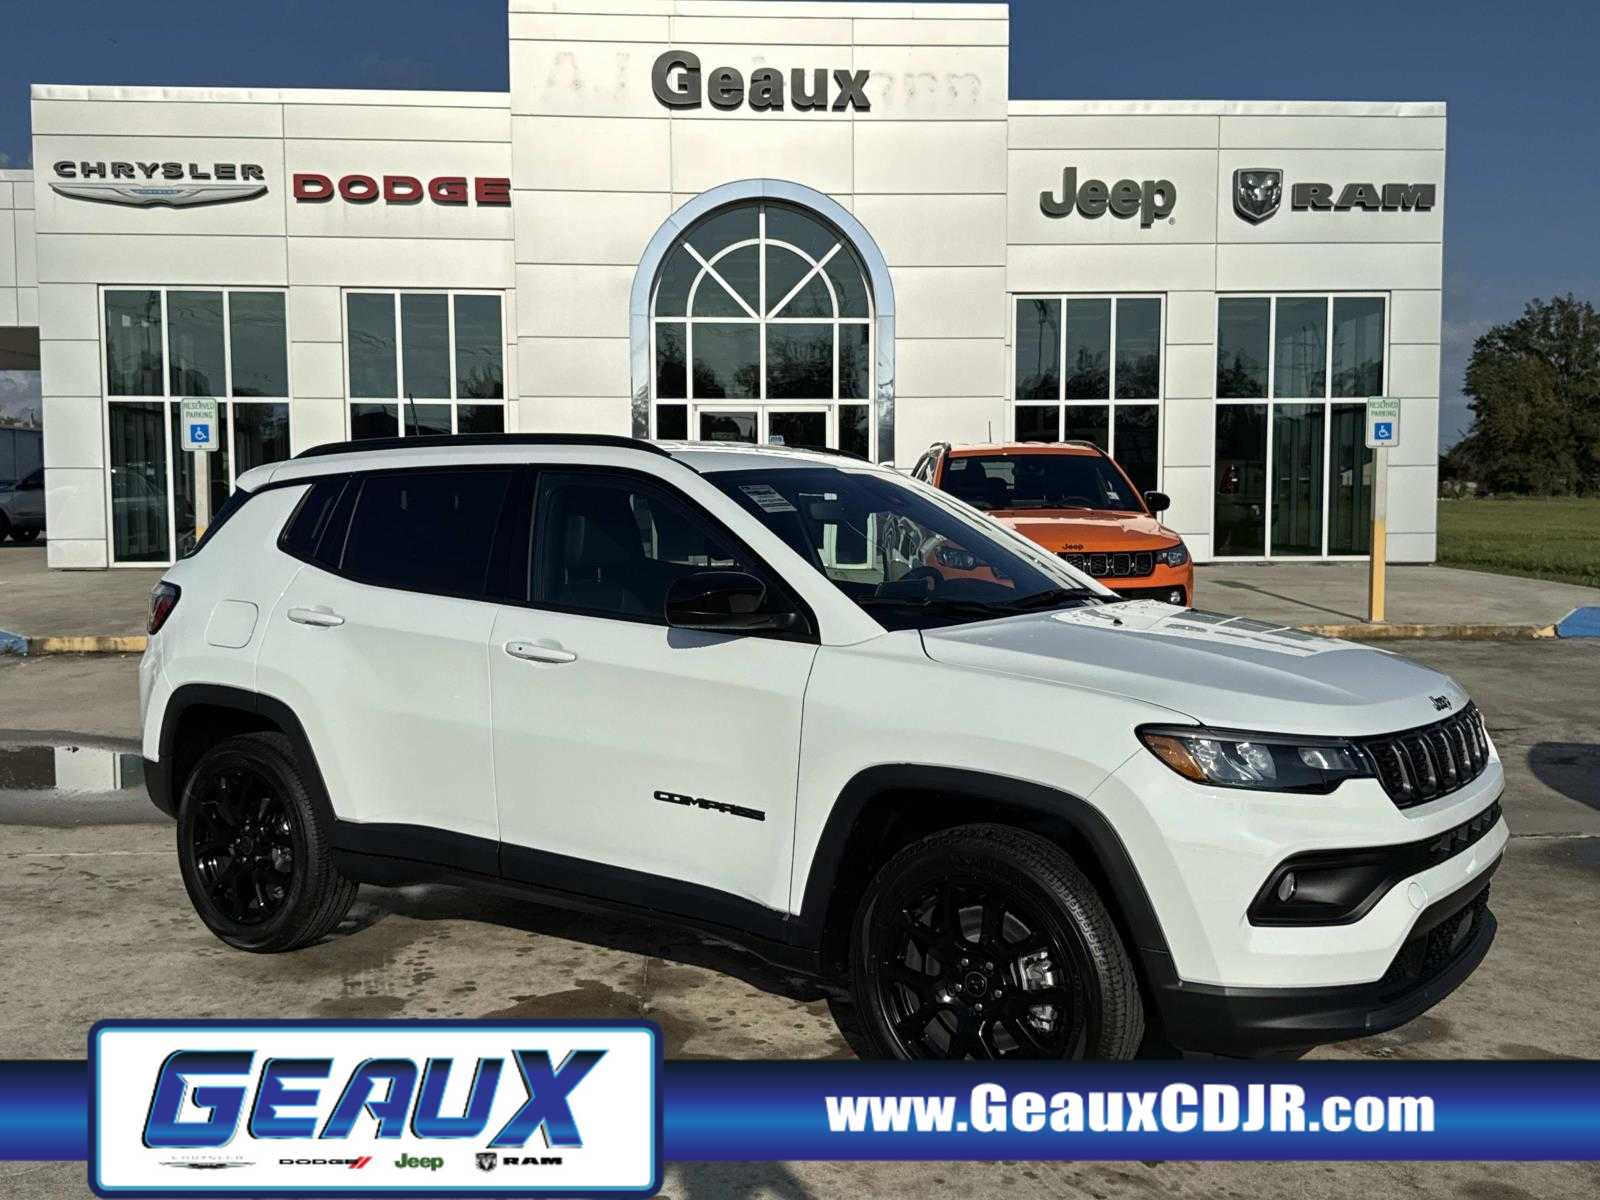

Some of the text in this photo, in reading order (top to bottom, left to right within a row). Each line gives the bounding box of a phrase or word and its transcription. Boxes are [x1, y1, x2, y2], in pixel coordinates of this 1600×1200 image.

[651, 50, 871, 112] Geaux
[53, 161, 265, 181] CHRYSLER
[293, 173, 511, 206] DODGE
[1039, 167, 1177, 229] Jeep
[1291, 183, 1436, 212] RAM
[1062, 543, 1085, 551] Jeep
[653, 790, 766, 821] COMPASS
